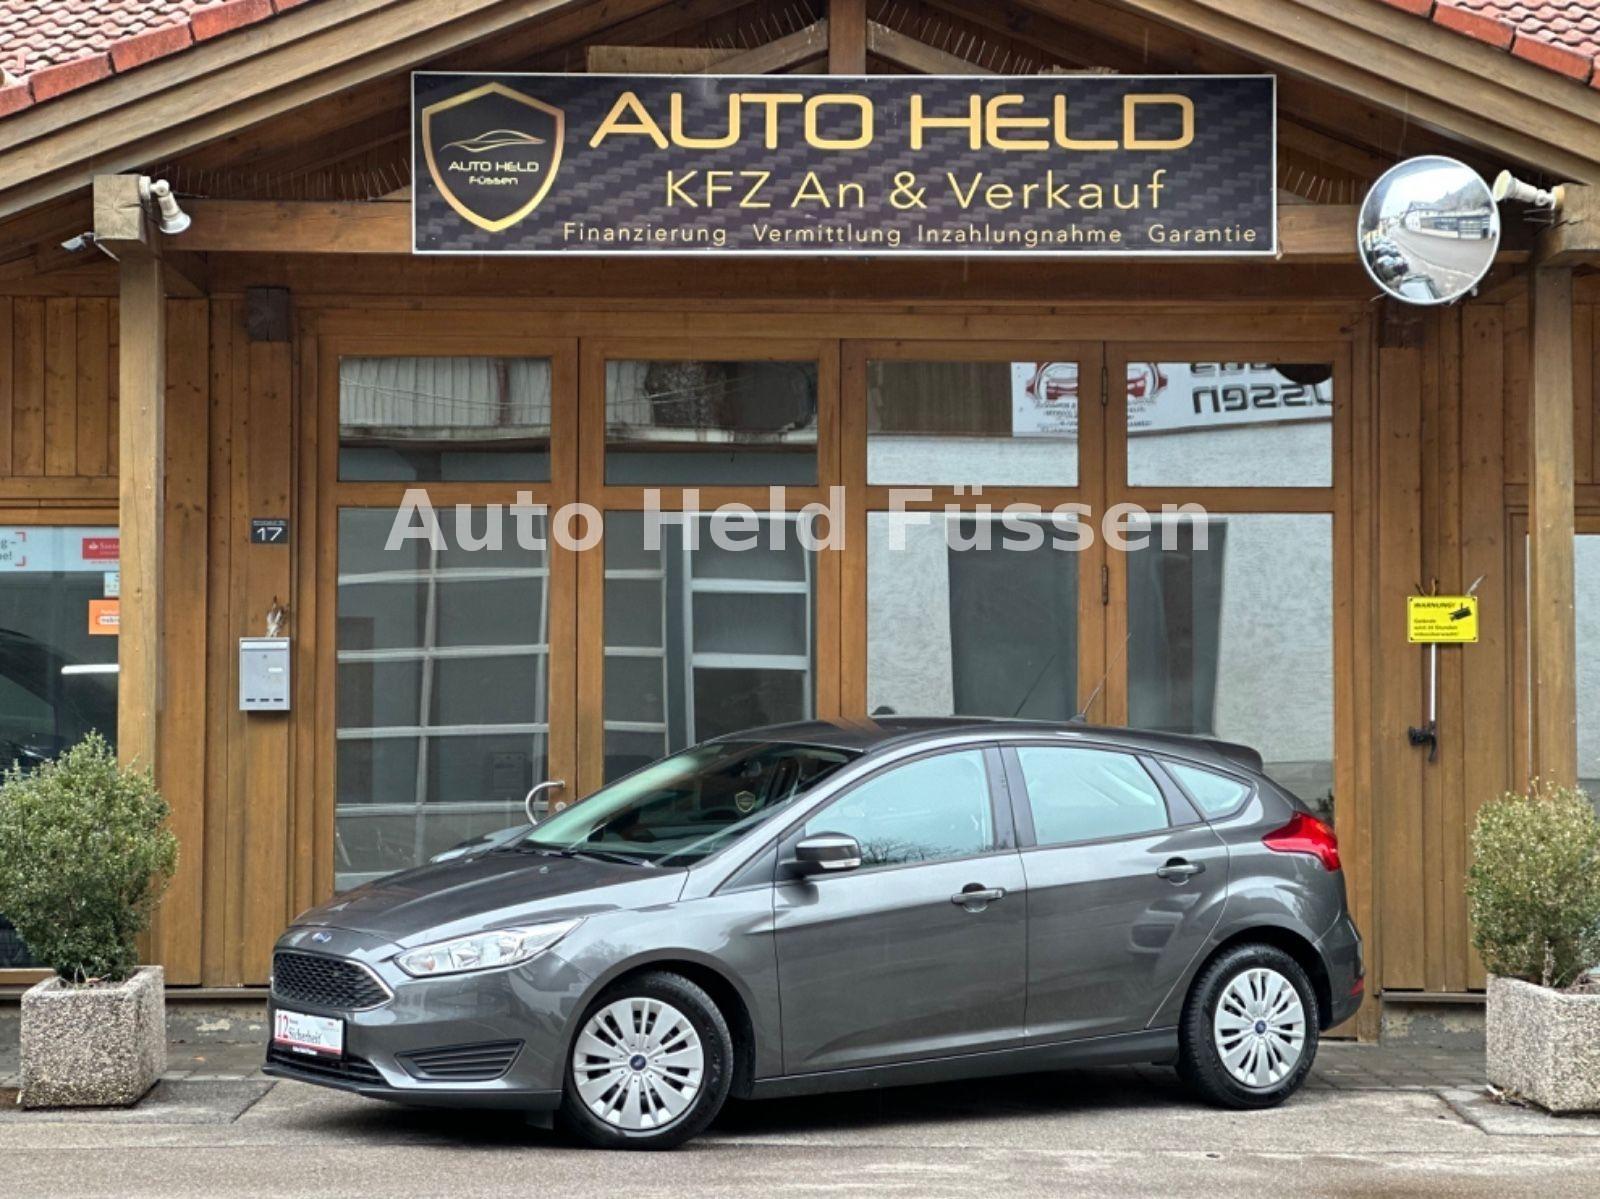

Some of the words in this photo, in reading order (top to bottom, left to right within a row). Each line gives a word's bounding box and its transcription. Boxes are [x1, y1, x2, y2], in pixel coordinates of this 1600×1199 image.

[589, 91, 874, 150] AUTO
[910, 94, 1195, 151] HELD
[448, 161, 492, 172] AUTO
[495, 161, 540, 172] HELD
[667, 170, 771, 208] KFZ
[791, 170, 865, 208] An
[889, 170, 927, 209] &
[947, 168, 1167, 209] Verkauf
[563, 223, 727, 246] Finanzierung
[753, 224, 901, 247] Vermittlung
[918, 224, 1122, 248] Inzahlungnahme
[1149, 224, 1257, 243] Garantie
[256, 527, 283, 541] 17
